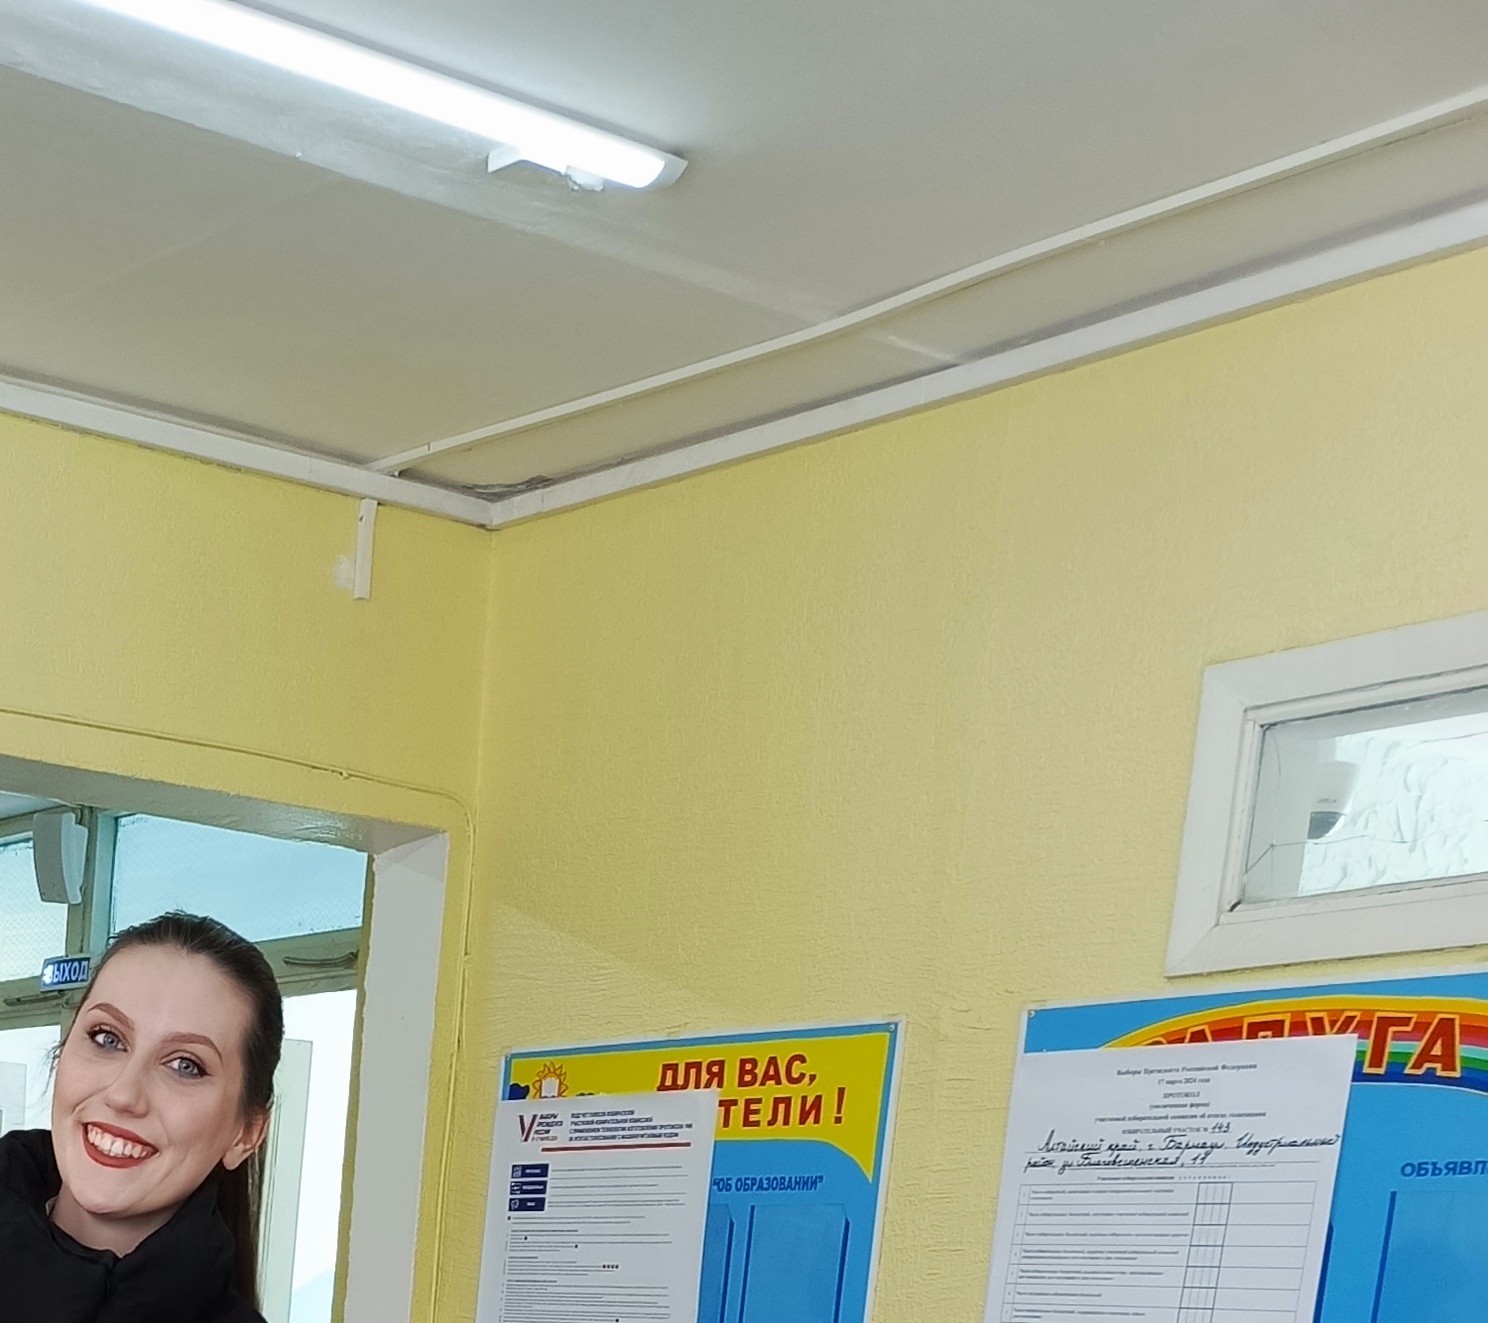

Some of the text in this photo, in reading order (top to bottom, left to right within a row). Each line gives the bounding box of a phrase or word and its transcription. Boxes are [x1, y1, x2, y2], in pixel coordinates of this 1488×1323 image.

[43, 961, 89, 984] ВЫХОД
[657, 1054, 817, 1092] ДЛЯ ВАС,
[718, 1087, 846, 1129] ТЕЛИ!
[1210, 1121, 1231, 1134] 143
[1400, 1160, 1488, 1178] ОБЪЯВЛ
